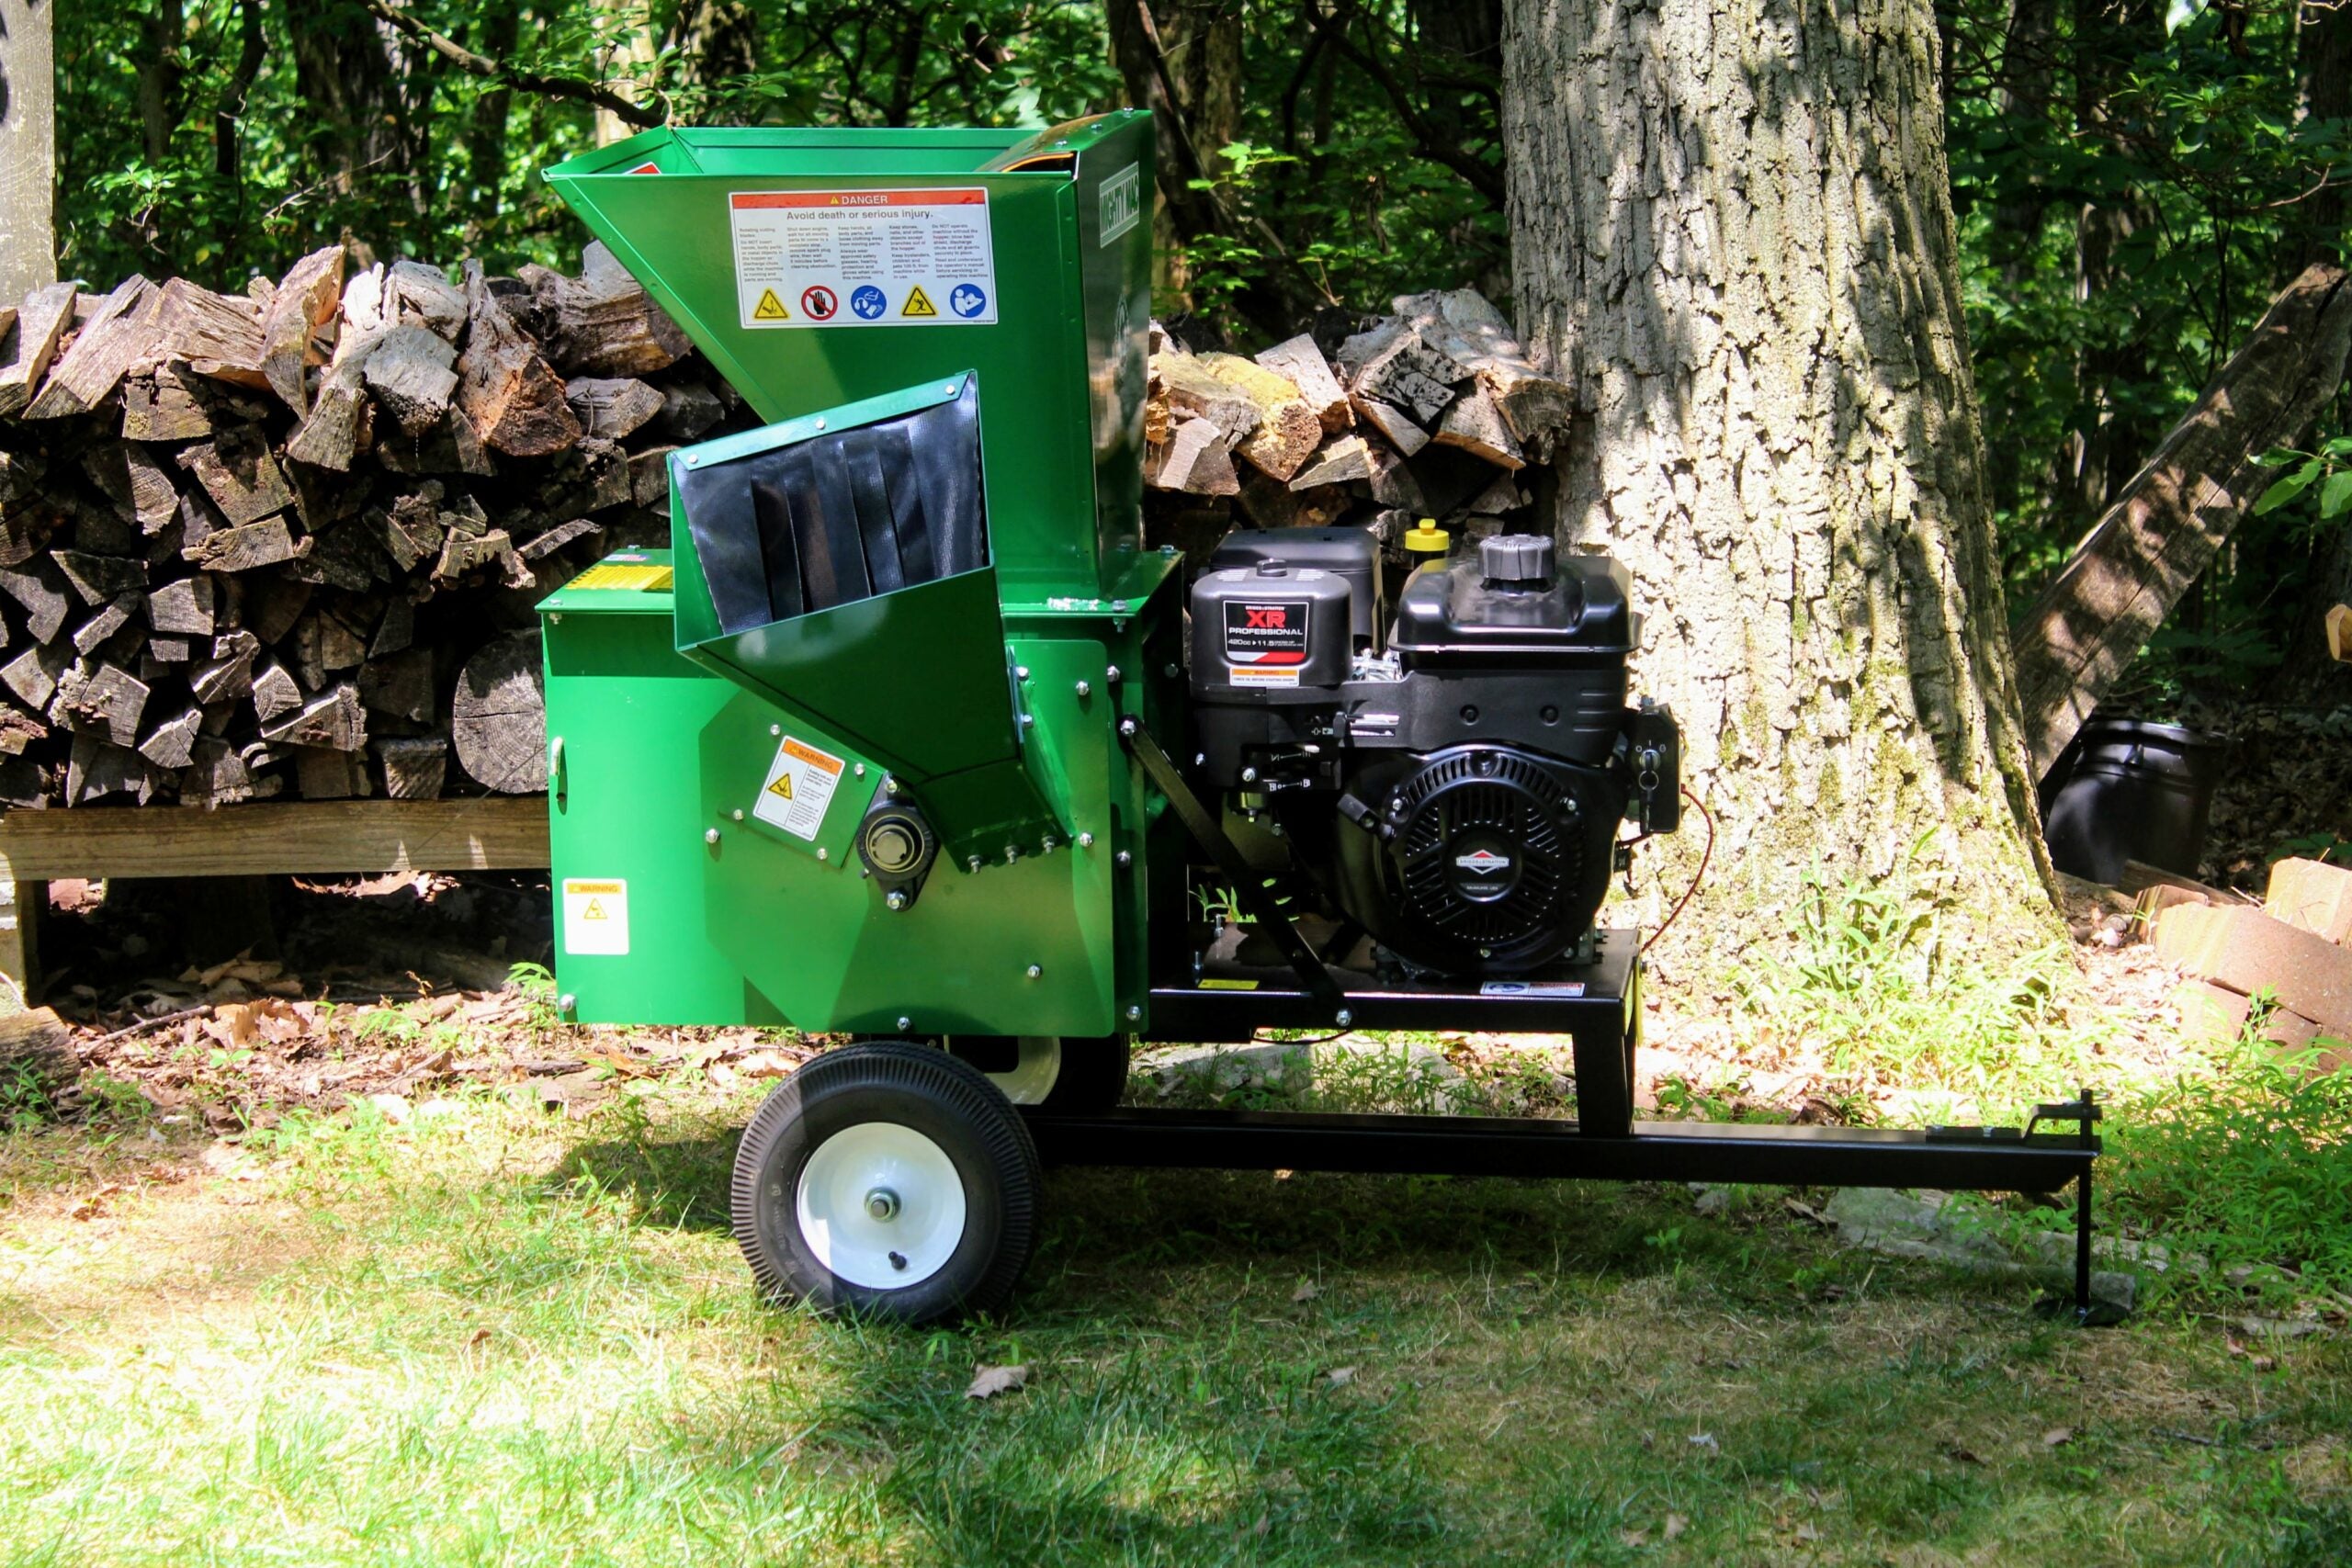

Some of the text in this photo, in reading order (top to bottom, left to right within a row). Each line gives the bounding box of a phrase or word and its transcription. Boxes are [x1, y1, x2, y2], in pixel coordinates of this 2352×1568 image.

[841, 195, 888, 205] DANGER
[786, 210, 815, 220] Avoid
[818, 210, 845, 220] death
[862, 209, 899, 219] serious
[901, 209, 933, 220] injury.
[1246, 610, 1286, 628] XR
[1229, 627, 1303, 635] PROFESSIONAL
[798, 749, 833, 770] WARNING
